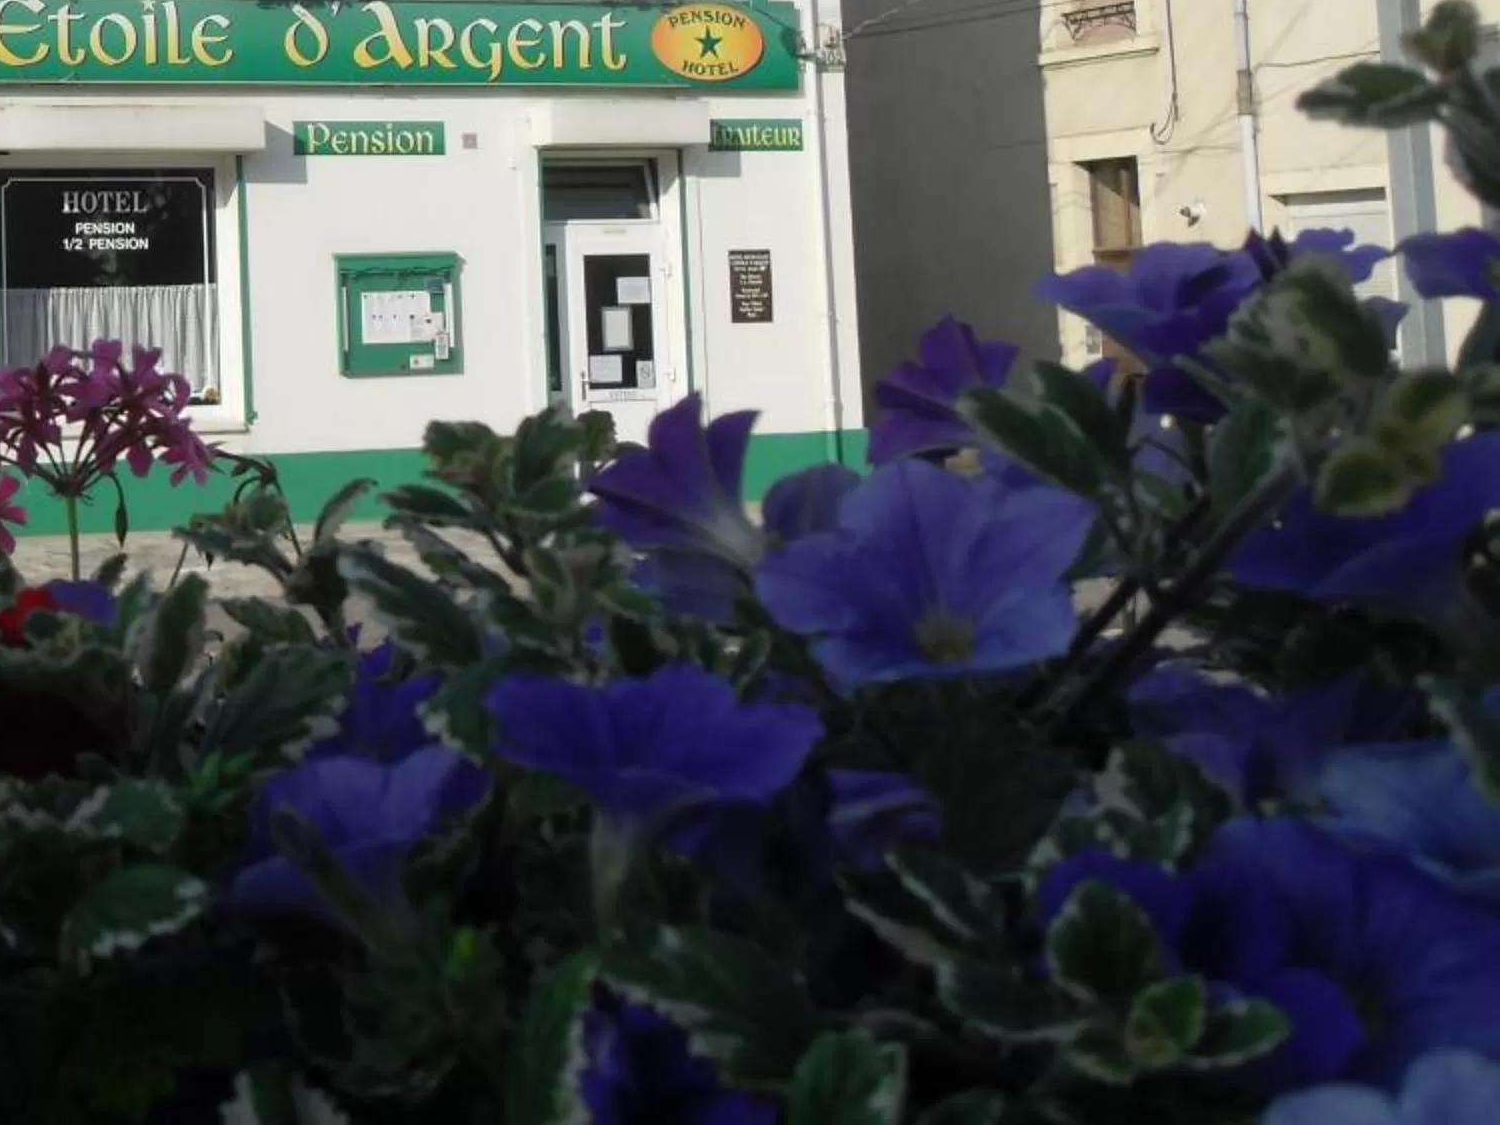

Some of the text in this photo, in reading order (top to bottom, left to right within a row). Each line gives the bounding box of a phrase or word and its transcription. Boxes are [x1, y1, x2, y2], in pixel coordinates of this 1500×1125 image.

[668, 9, 746, 30] PENSION
[681, 57, 739, 76] HOTEL
[307, 123, 434, 154] Pension
[62, 191, 148, 214] HOTEL
[75, 222, 135, 235] PENSION
[63, 238, 149, 251] 1/2 PENSION
